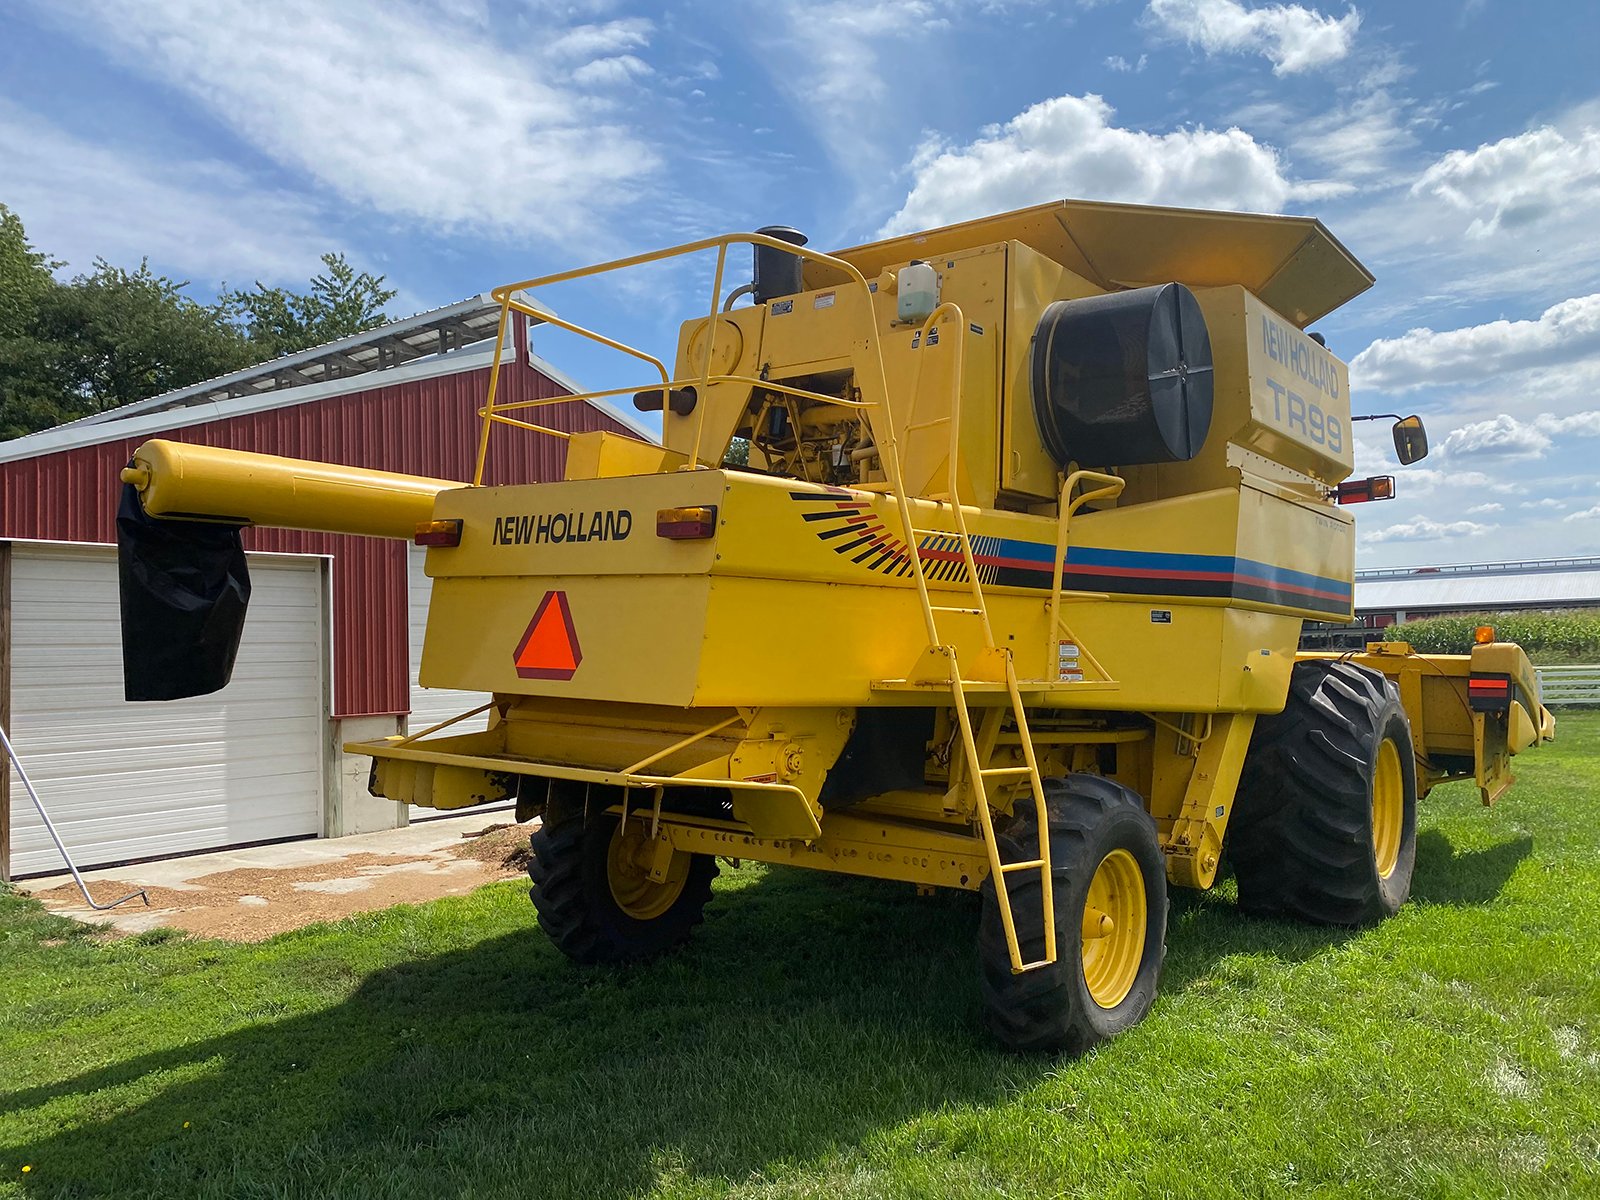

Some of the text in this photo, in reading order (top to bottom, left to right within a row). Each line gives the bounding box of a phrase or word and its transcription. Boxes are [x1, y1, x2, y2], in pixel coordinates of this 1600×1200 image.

[1262, 316, 1339, 399] NEW HOLLAND
[1266, 377, 1341, 453] TR99
[492, 510, 632, 545] NEW HOLLAND
